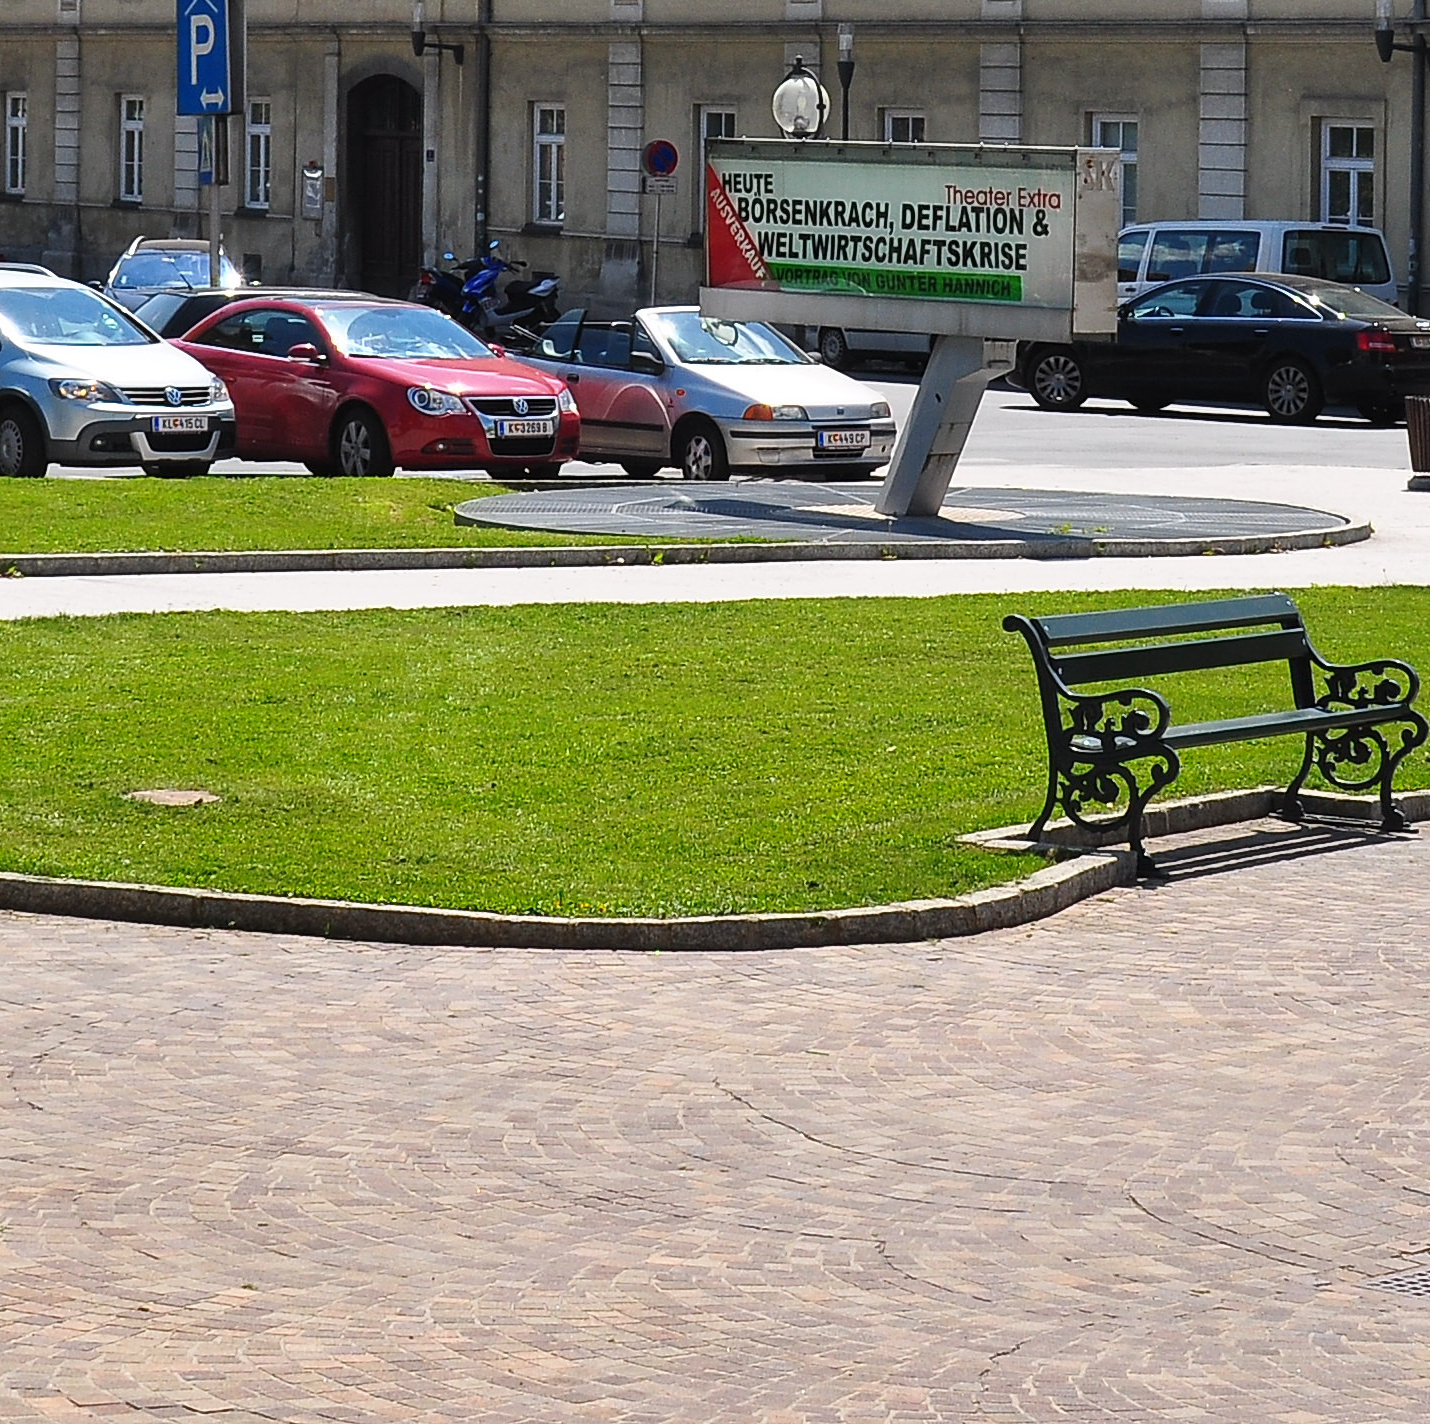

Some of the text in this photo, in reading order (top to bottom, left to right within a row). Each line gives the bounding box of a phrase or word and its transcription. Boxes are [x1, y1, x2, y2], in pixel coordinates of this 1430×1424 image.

[190, 14, 215, 85] P
[722, 173, 774, 194] HEUTE
[945, 184, 1061, 210] Theater Extra
[737, 189, 1050, 237] BÖRSENKRACH, DEFLATION &
[757, 230, 1028, 271] WELTWIRTSCHAFTSKRISE
[775, 267, 839, 287] VORTRAG
[841, 270, 871, 289] VON
[943, 276, 1012, 297] HANNICH
